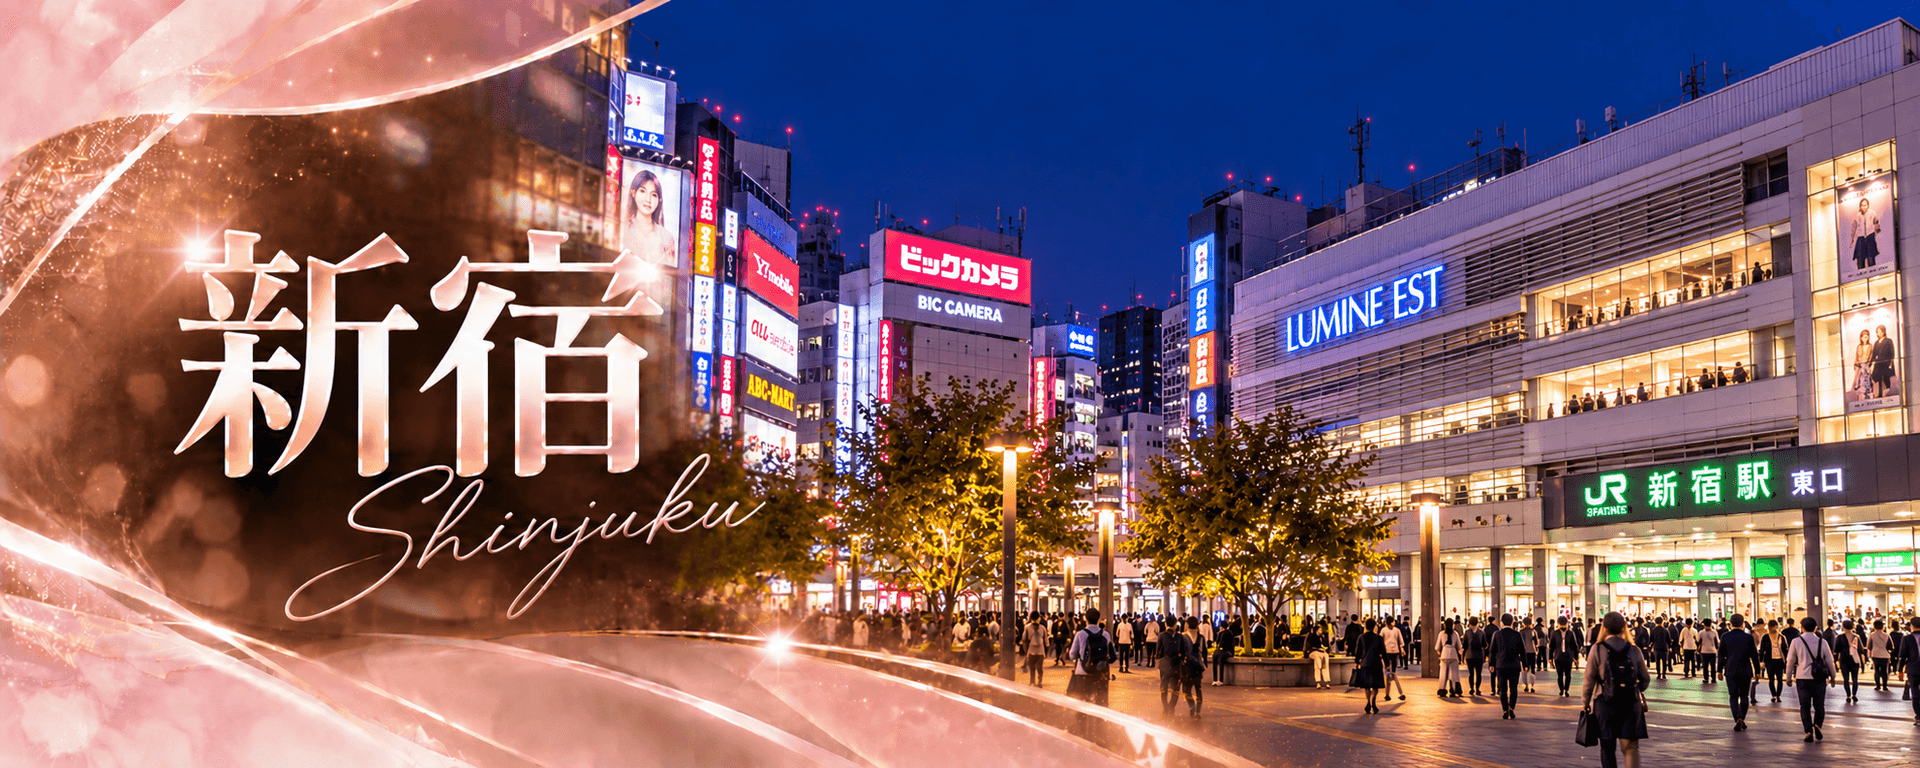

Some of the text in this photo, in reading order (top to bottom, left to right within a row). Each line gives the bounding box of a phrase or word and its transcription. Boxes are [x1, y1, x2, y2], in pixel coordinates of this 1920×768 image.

[900, 244, 1018, 291] ビックカメラ
[917, 294, 1003, 323] BIC CAMERA
[1286, 265, 1443, 352] LUMINE EST
[1584, 460, 1843, 508] JR 新宿駅 東口
